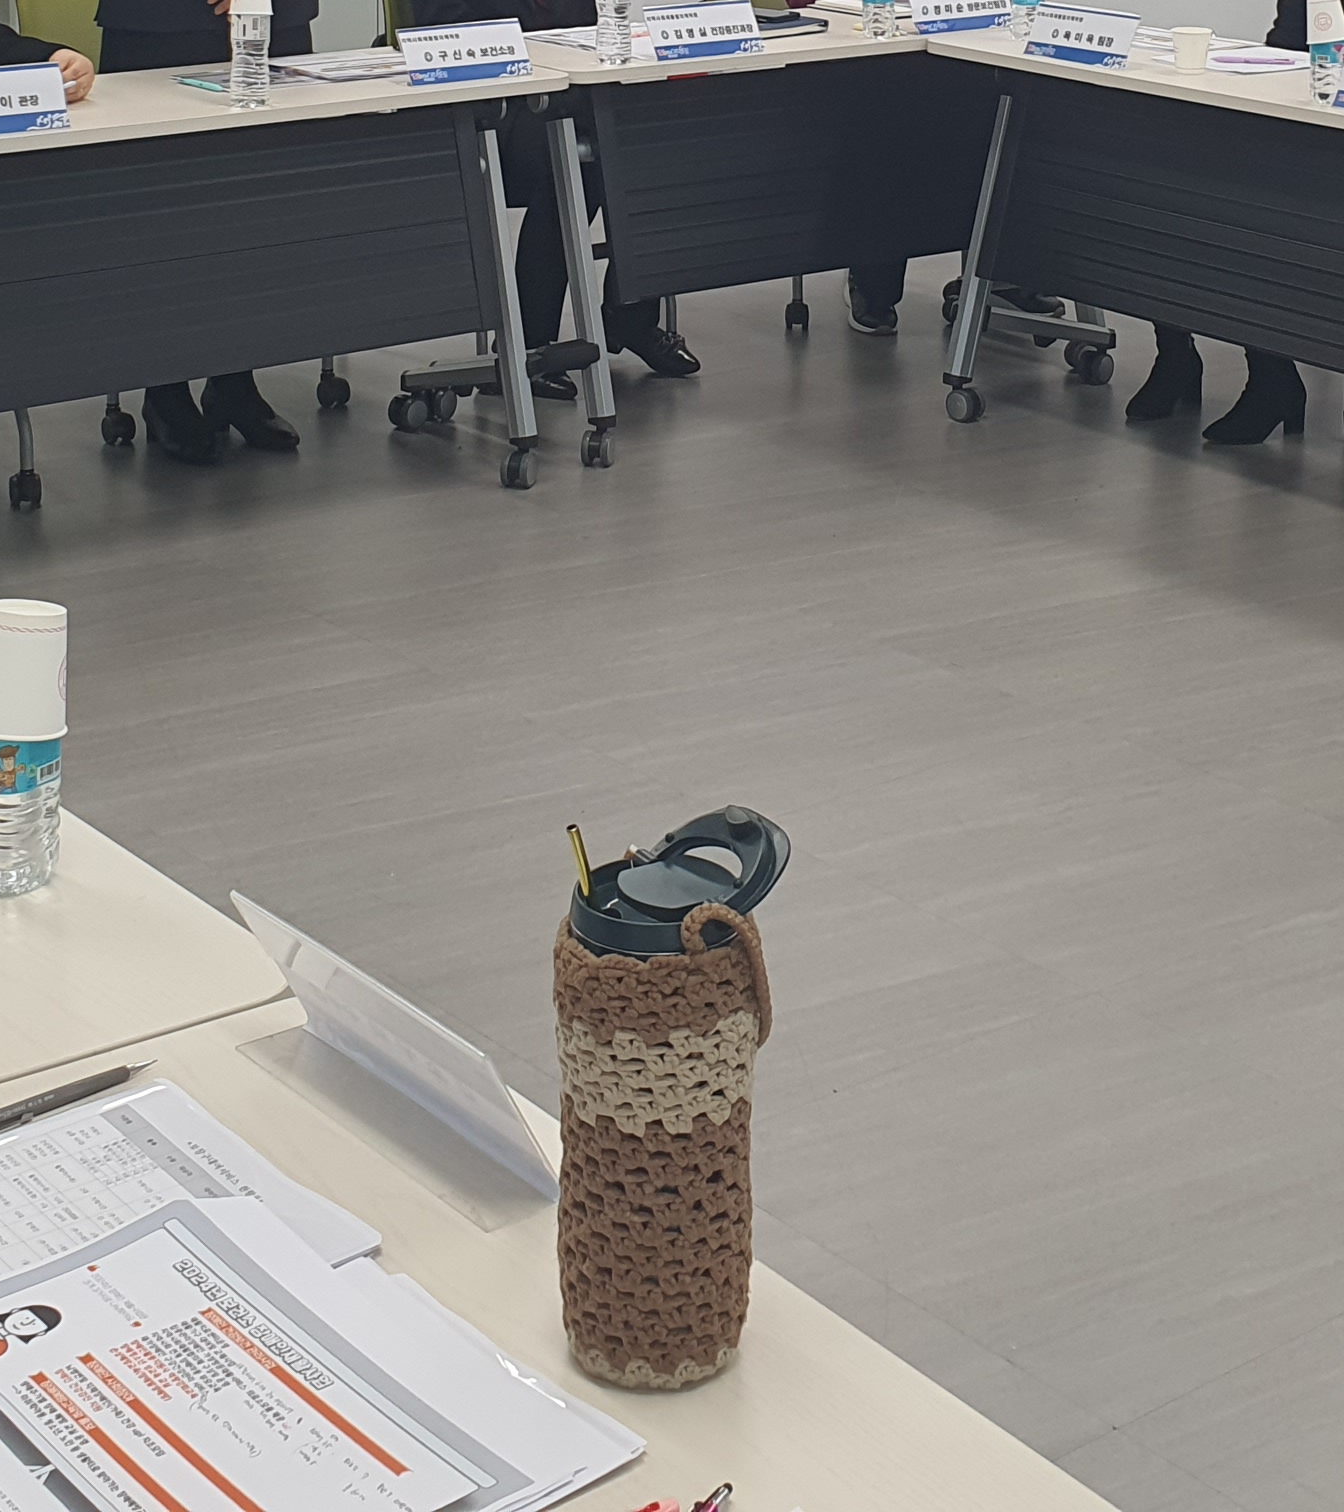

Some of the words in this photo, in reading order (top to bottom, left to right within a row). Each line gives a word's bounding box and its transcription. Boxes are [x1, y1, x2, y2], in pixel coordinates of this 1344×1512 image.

[1097, 36, 1114, 47] 팀장
[480, 45, 516, 57] 보건소장
[18, 94, 39, 107] 관장
[170, 1258, 229, 1301] 2024년
[215, 1296, 261, 1328] 보건소
[246, 1323, 336, 1390] 장애인재활사업
